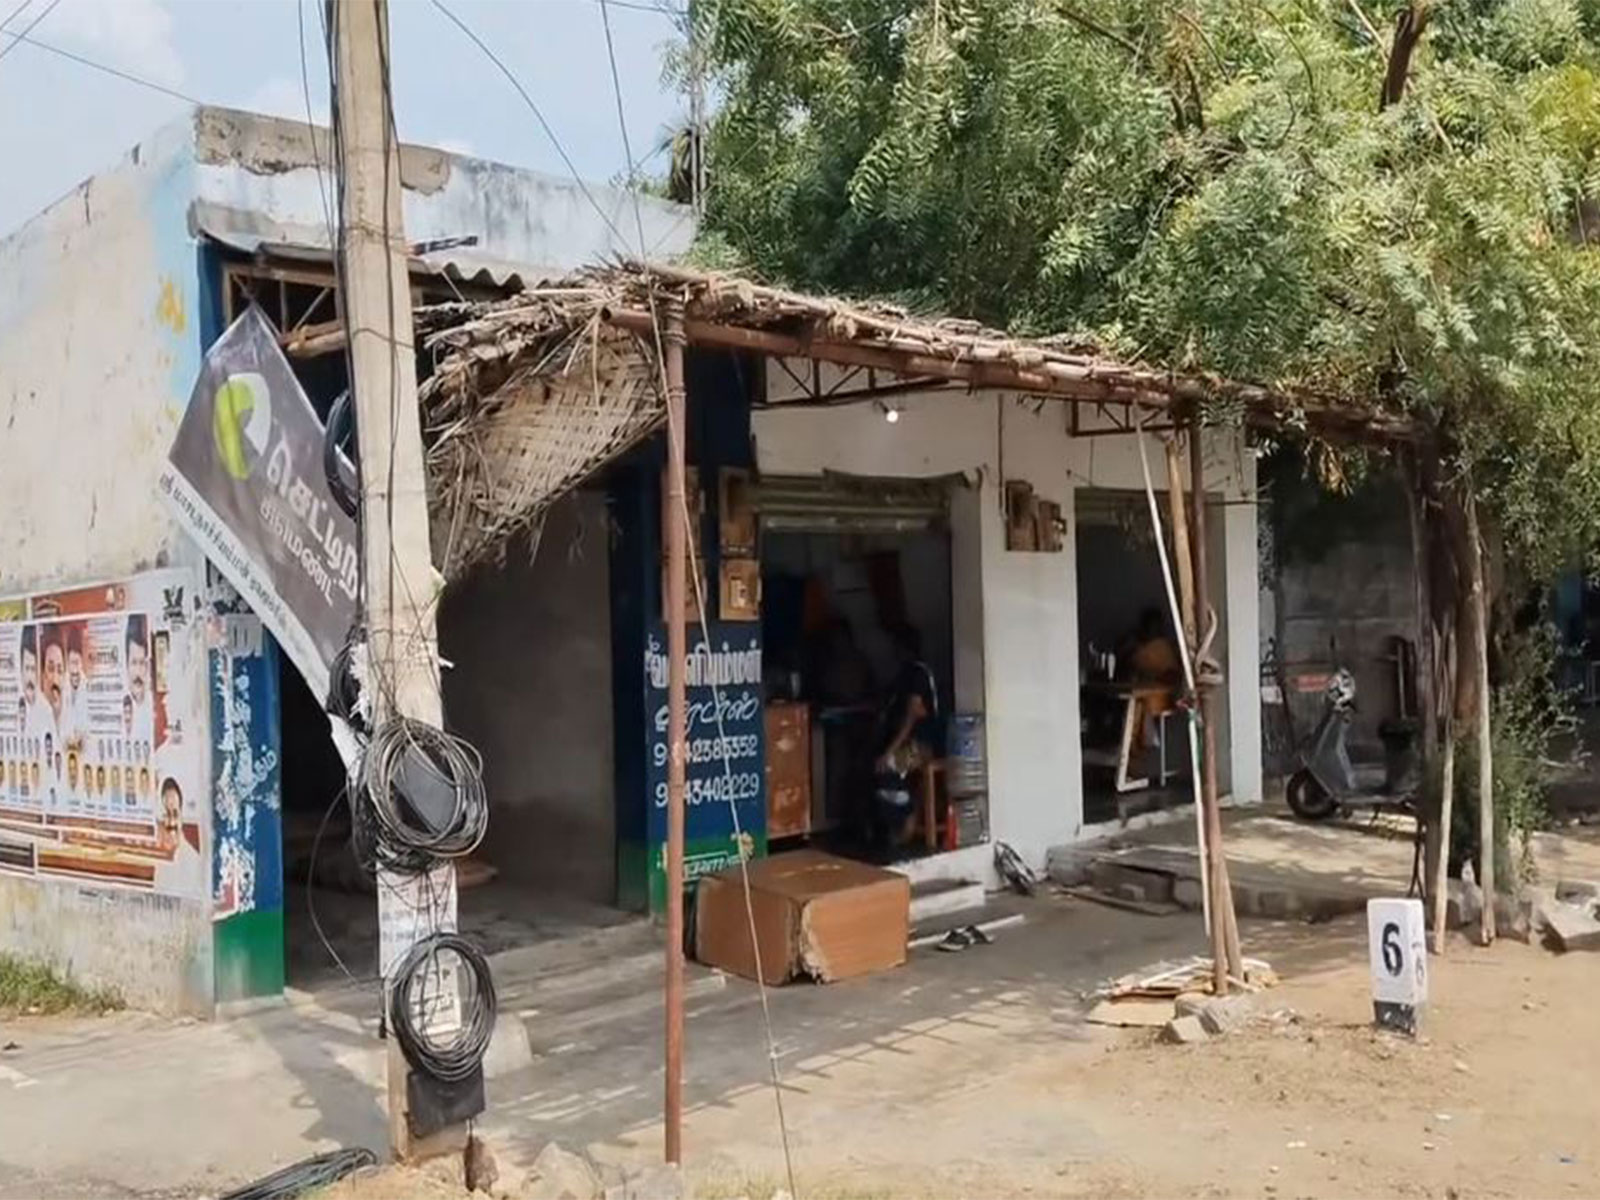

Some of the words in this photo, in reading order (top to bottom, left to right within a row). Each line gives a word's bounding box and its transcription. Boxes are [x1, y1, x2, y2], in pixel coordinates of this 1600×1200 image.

[653, 734, 758, 767] 942385352
[654, 773, 760, 808] 943402229
[1382, 922, 1403, 977] 6
